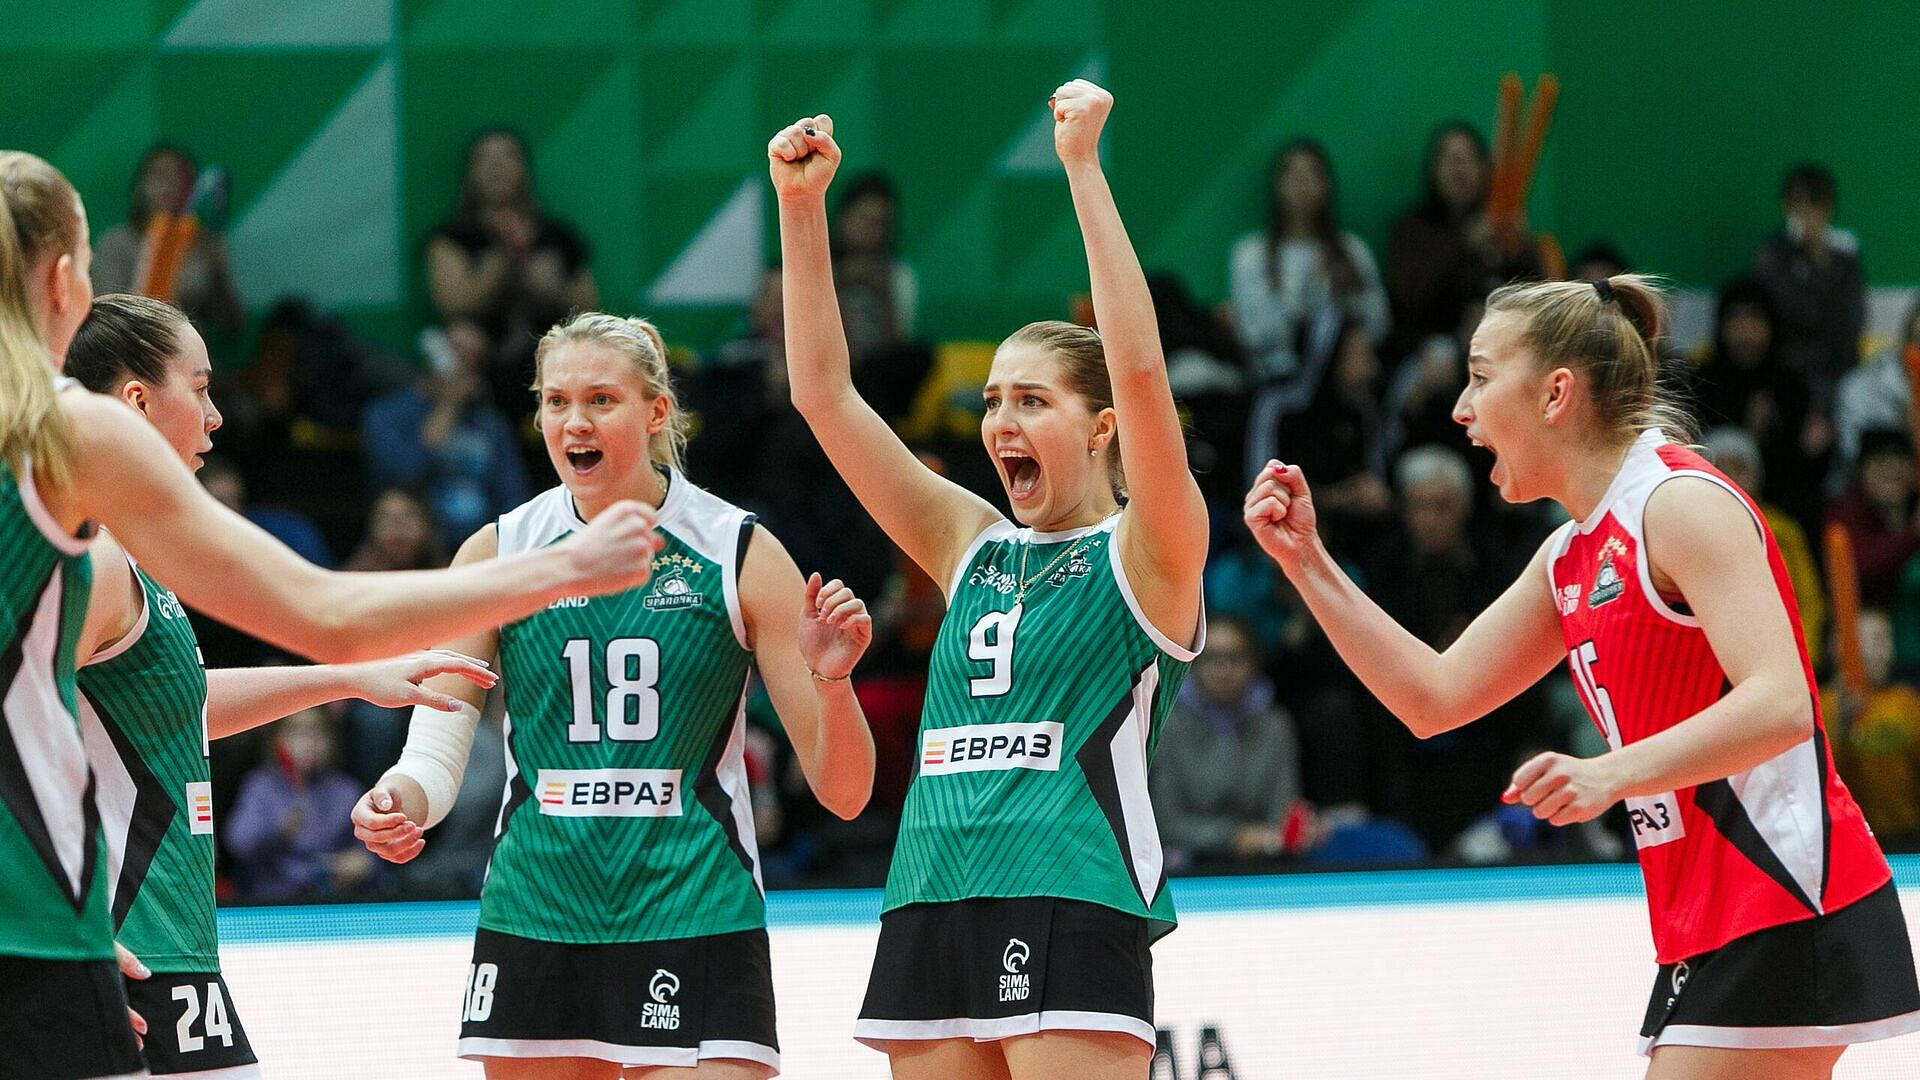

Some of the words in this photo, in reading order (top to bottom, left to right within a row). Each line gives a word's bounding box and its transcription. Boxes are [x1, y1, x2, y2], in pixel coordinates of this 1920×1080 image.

[968, 602, 1023, 698] 9
[562, 637, 660, 743] 18
[951, 733, 1052, 763] ЕВРАЗ
[571, 781, 675, 806] ЕВРАЗ
[999, 974, 1030, 989] SIMA
[999, 987, 1030, 1002] LAND
[171, 982, 234, 1054] 24
[640, 1014, 680, 1030] LAND
[642, 1002, 680, 1018] SIMA
